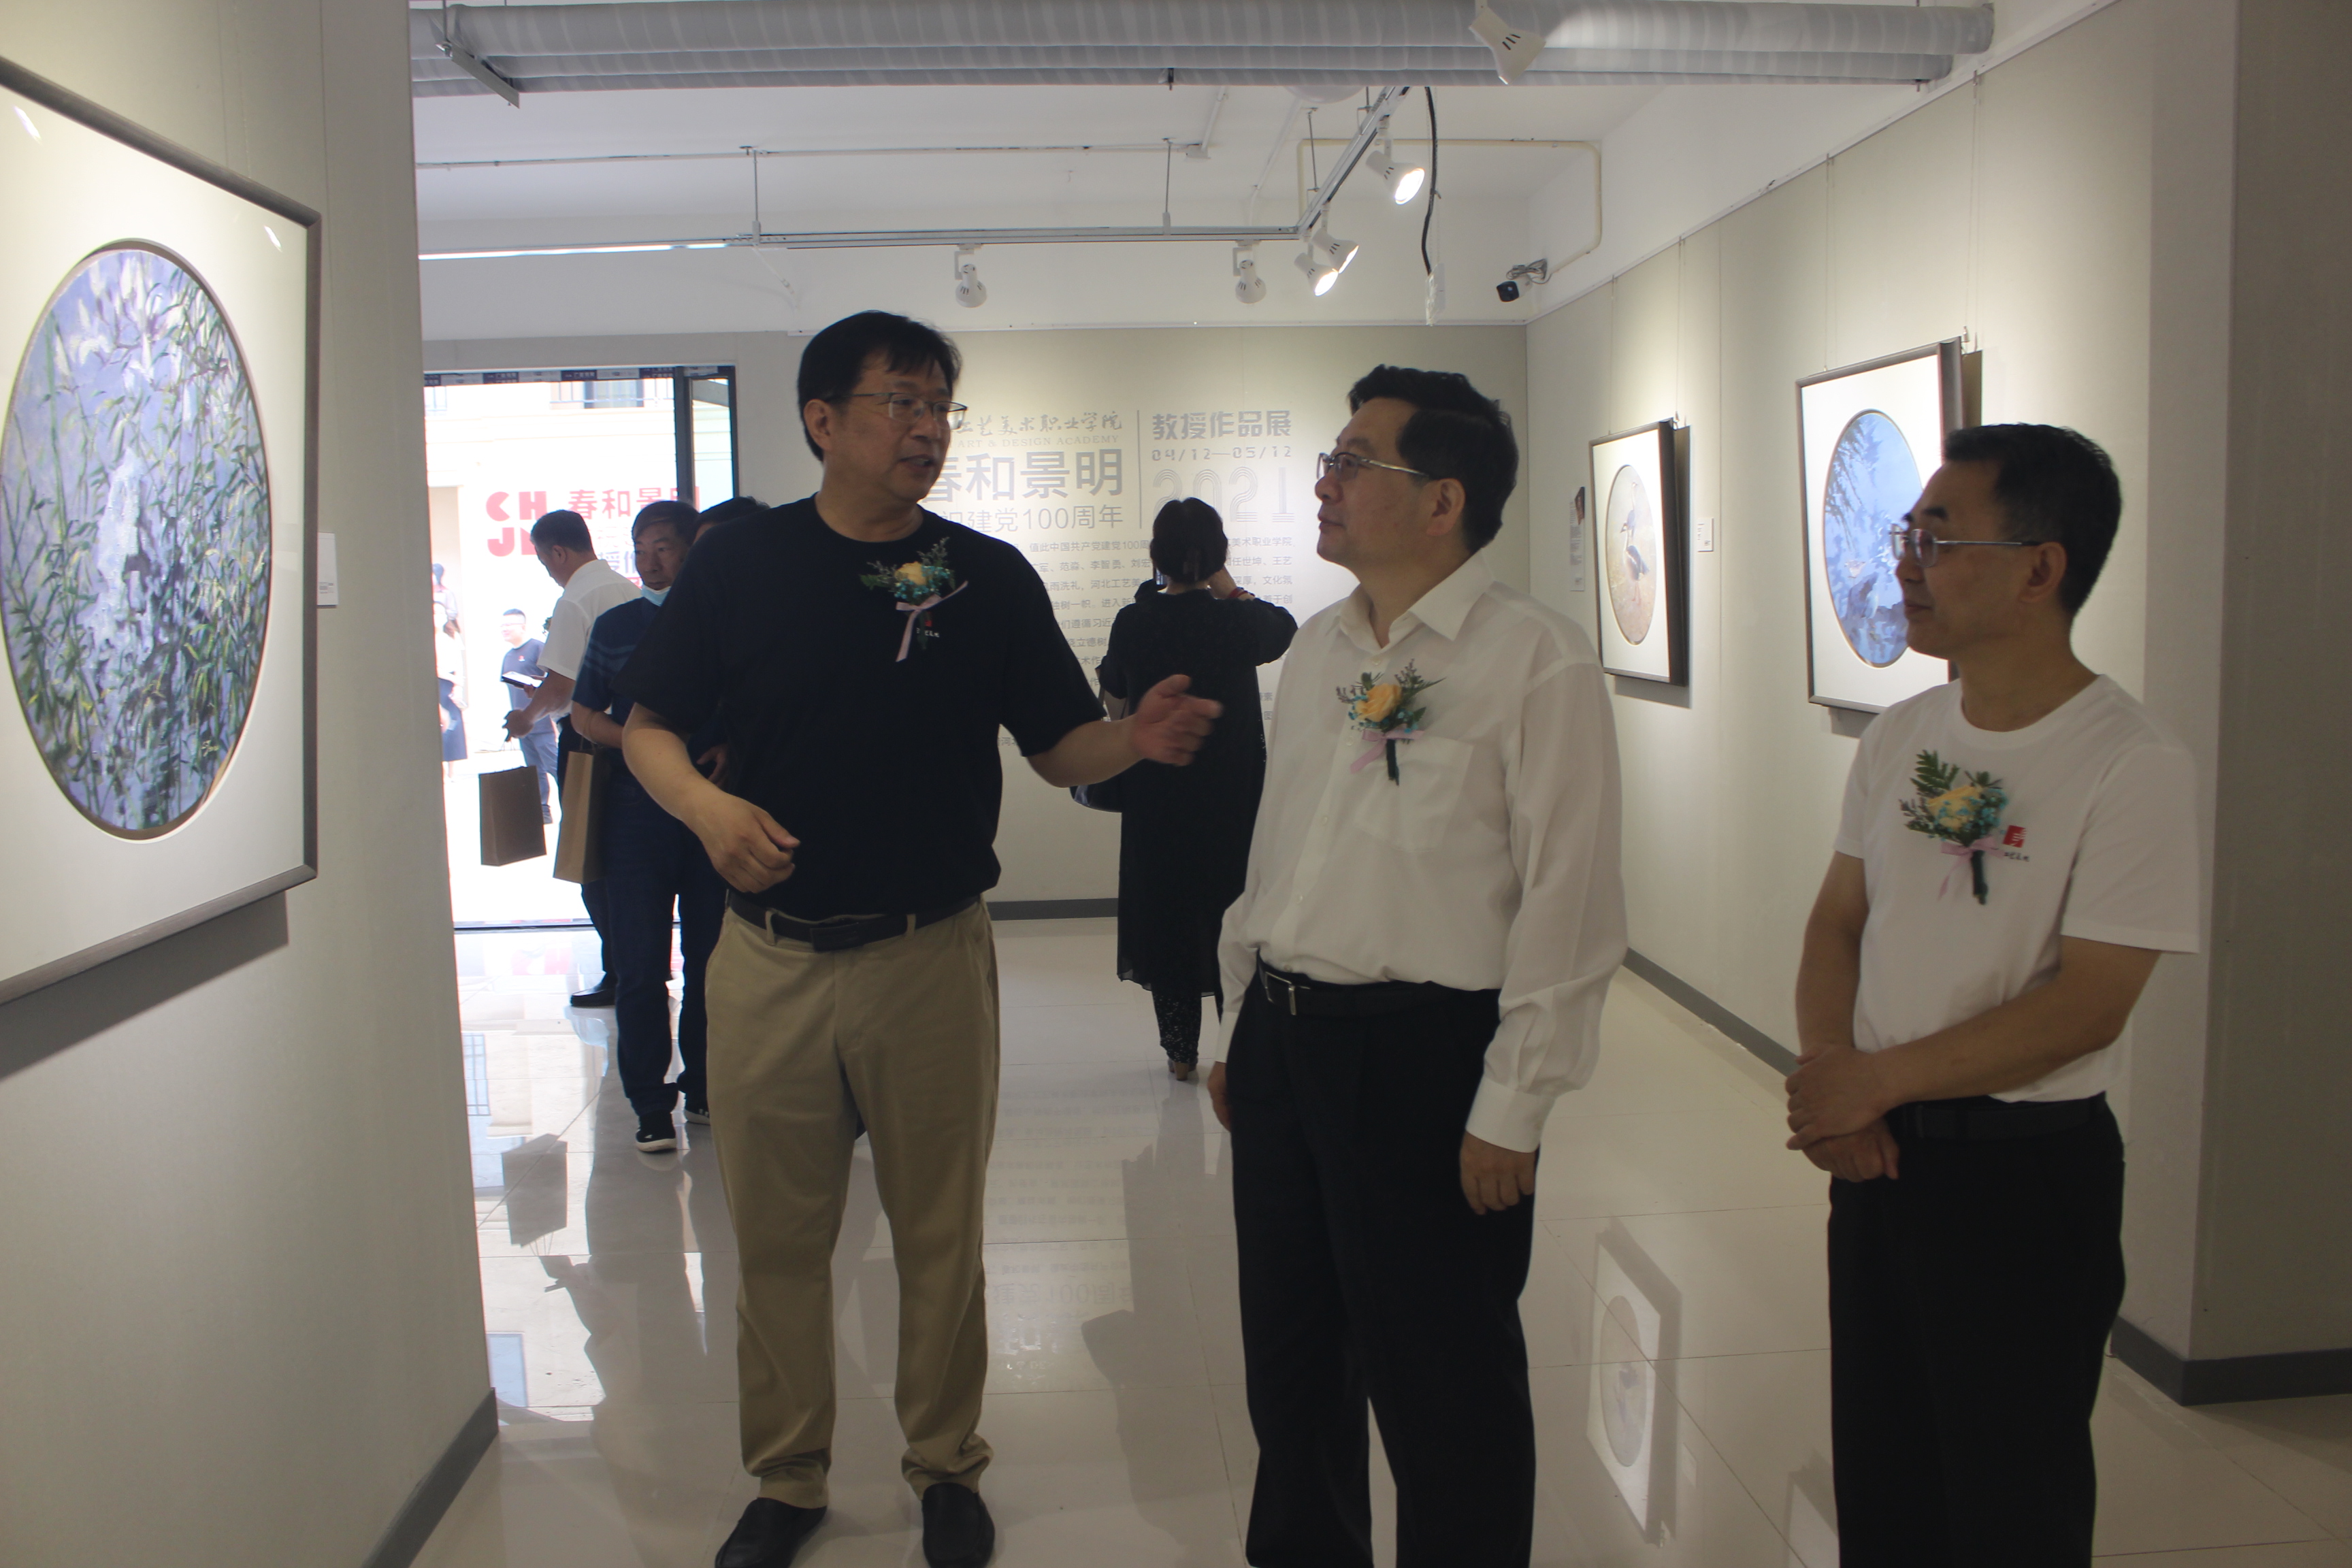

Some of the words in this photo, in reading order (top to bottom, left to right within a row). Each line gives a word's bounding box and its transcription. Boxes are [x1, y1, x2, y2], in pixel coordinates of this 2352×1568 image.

[1152, 410, 1292, 441] 教授作品展
[958, 439, 983, 448] ART
[988, 439, 997, 448] &
[1002, 438, 1051, 448] DESIGN
[1057, 435, 1119, 445] ACADEMY
[486, 491, 547, 521] CH
[1043, 577, 1150, 591] 雨洗礼，河北工艺美
